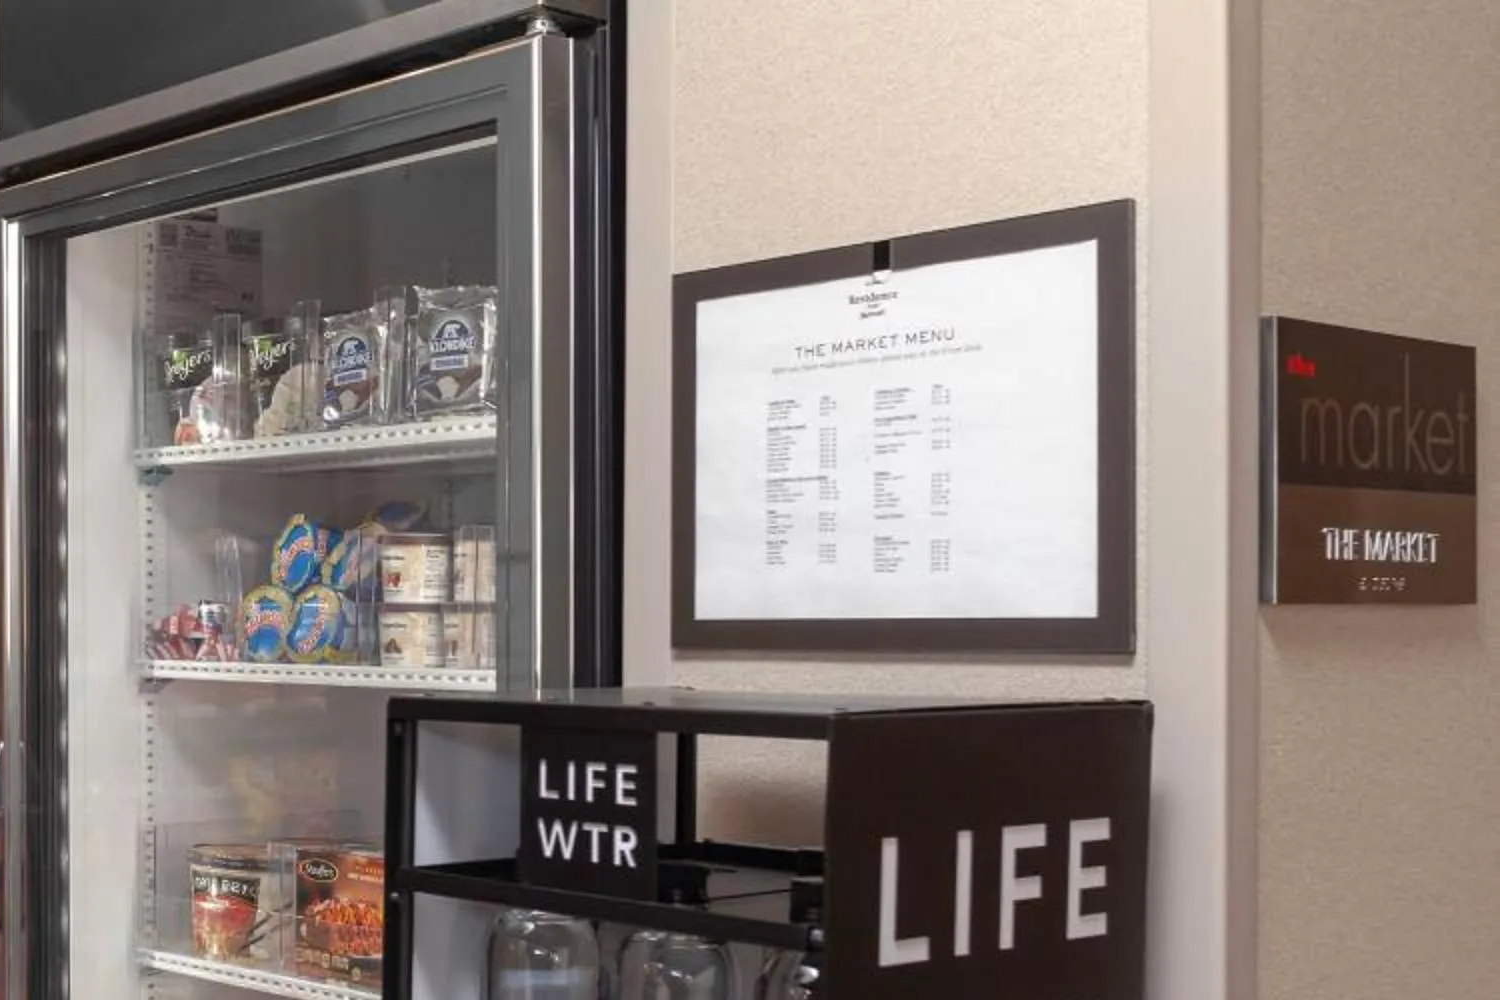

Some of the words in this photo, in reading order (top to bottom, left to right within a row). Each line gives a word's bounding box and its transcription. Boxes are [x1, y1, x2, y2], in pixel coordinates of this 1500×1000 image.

[795, 343, 826, 360] THE
[832, 334, 899, 354] MARKET
[905, 328, 956, 345] MENU
[1300, 352, 1470, 476] market
[1322, 527, 1359, 560] THE
[1364, 529, 1441, 563] MARKET
[538, 758, 638, 808] LIFE
[537, 817, 638, 869] WTR
[876, 817, 1112, 968] LIFE
